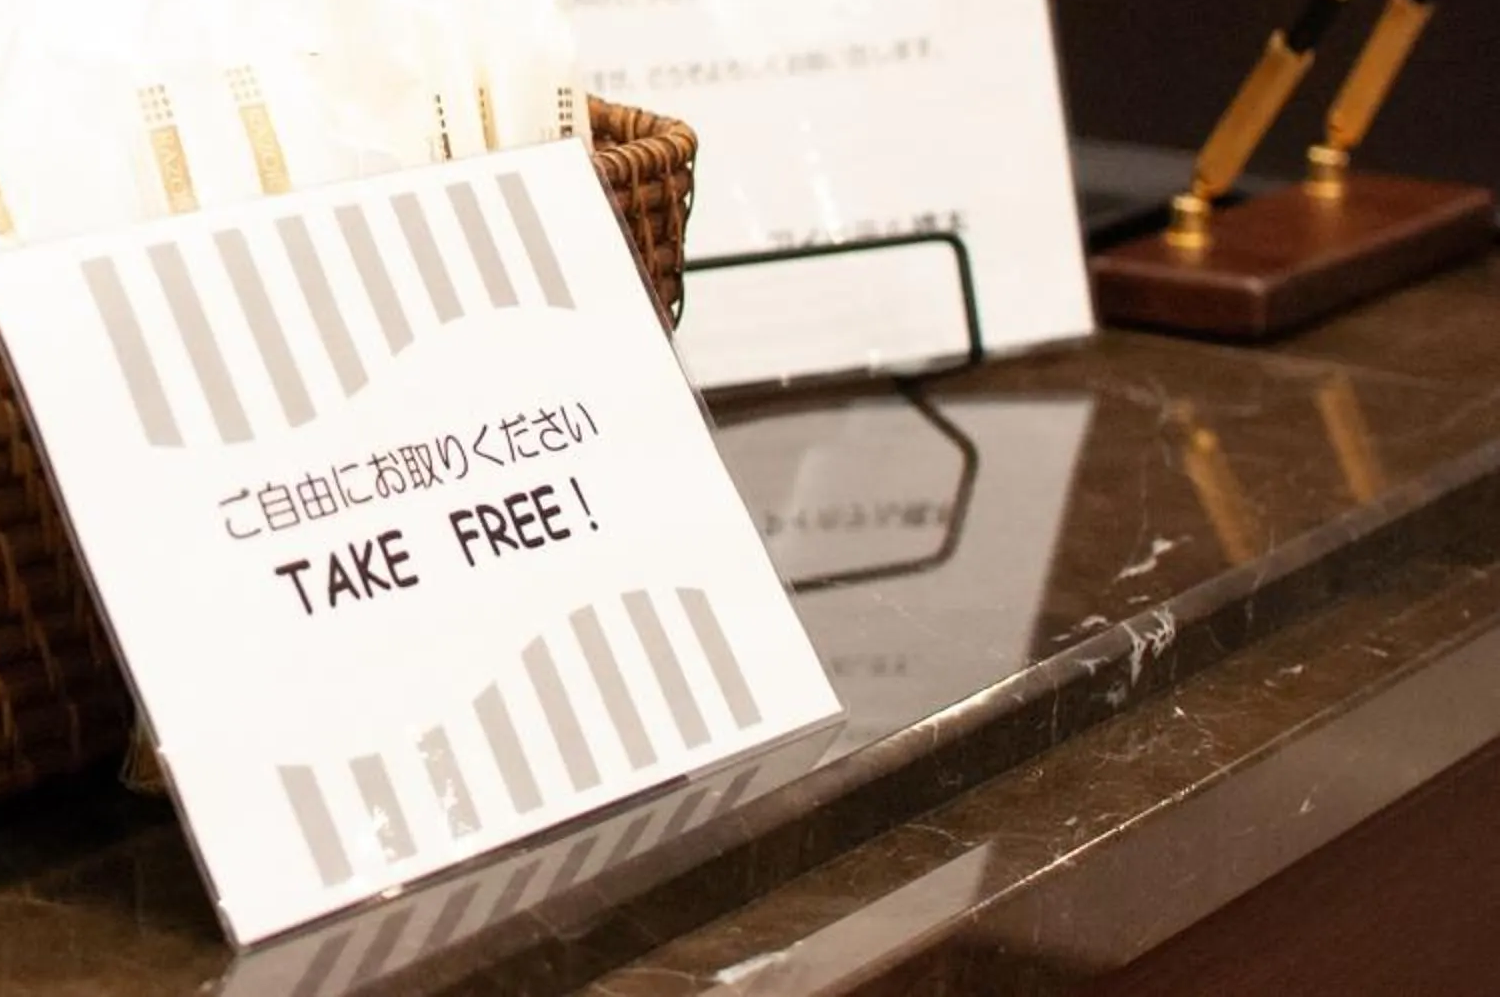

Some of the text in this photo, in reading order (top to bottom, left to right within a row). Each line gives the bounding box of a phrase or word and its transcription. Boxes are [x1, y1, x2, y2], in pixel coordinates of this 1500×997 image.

[218, 402, 599, 540] ご自由にお取りください
[274, 476, 599, 615] TAKE FREE!
